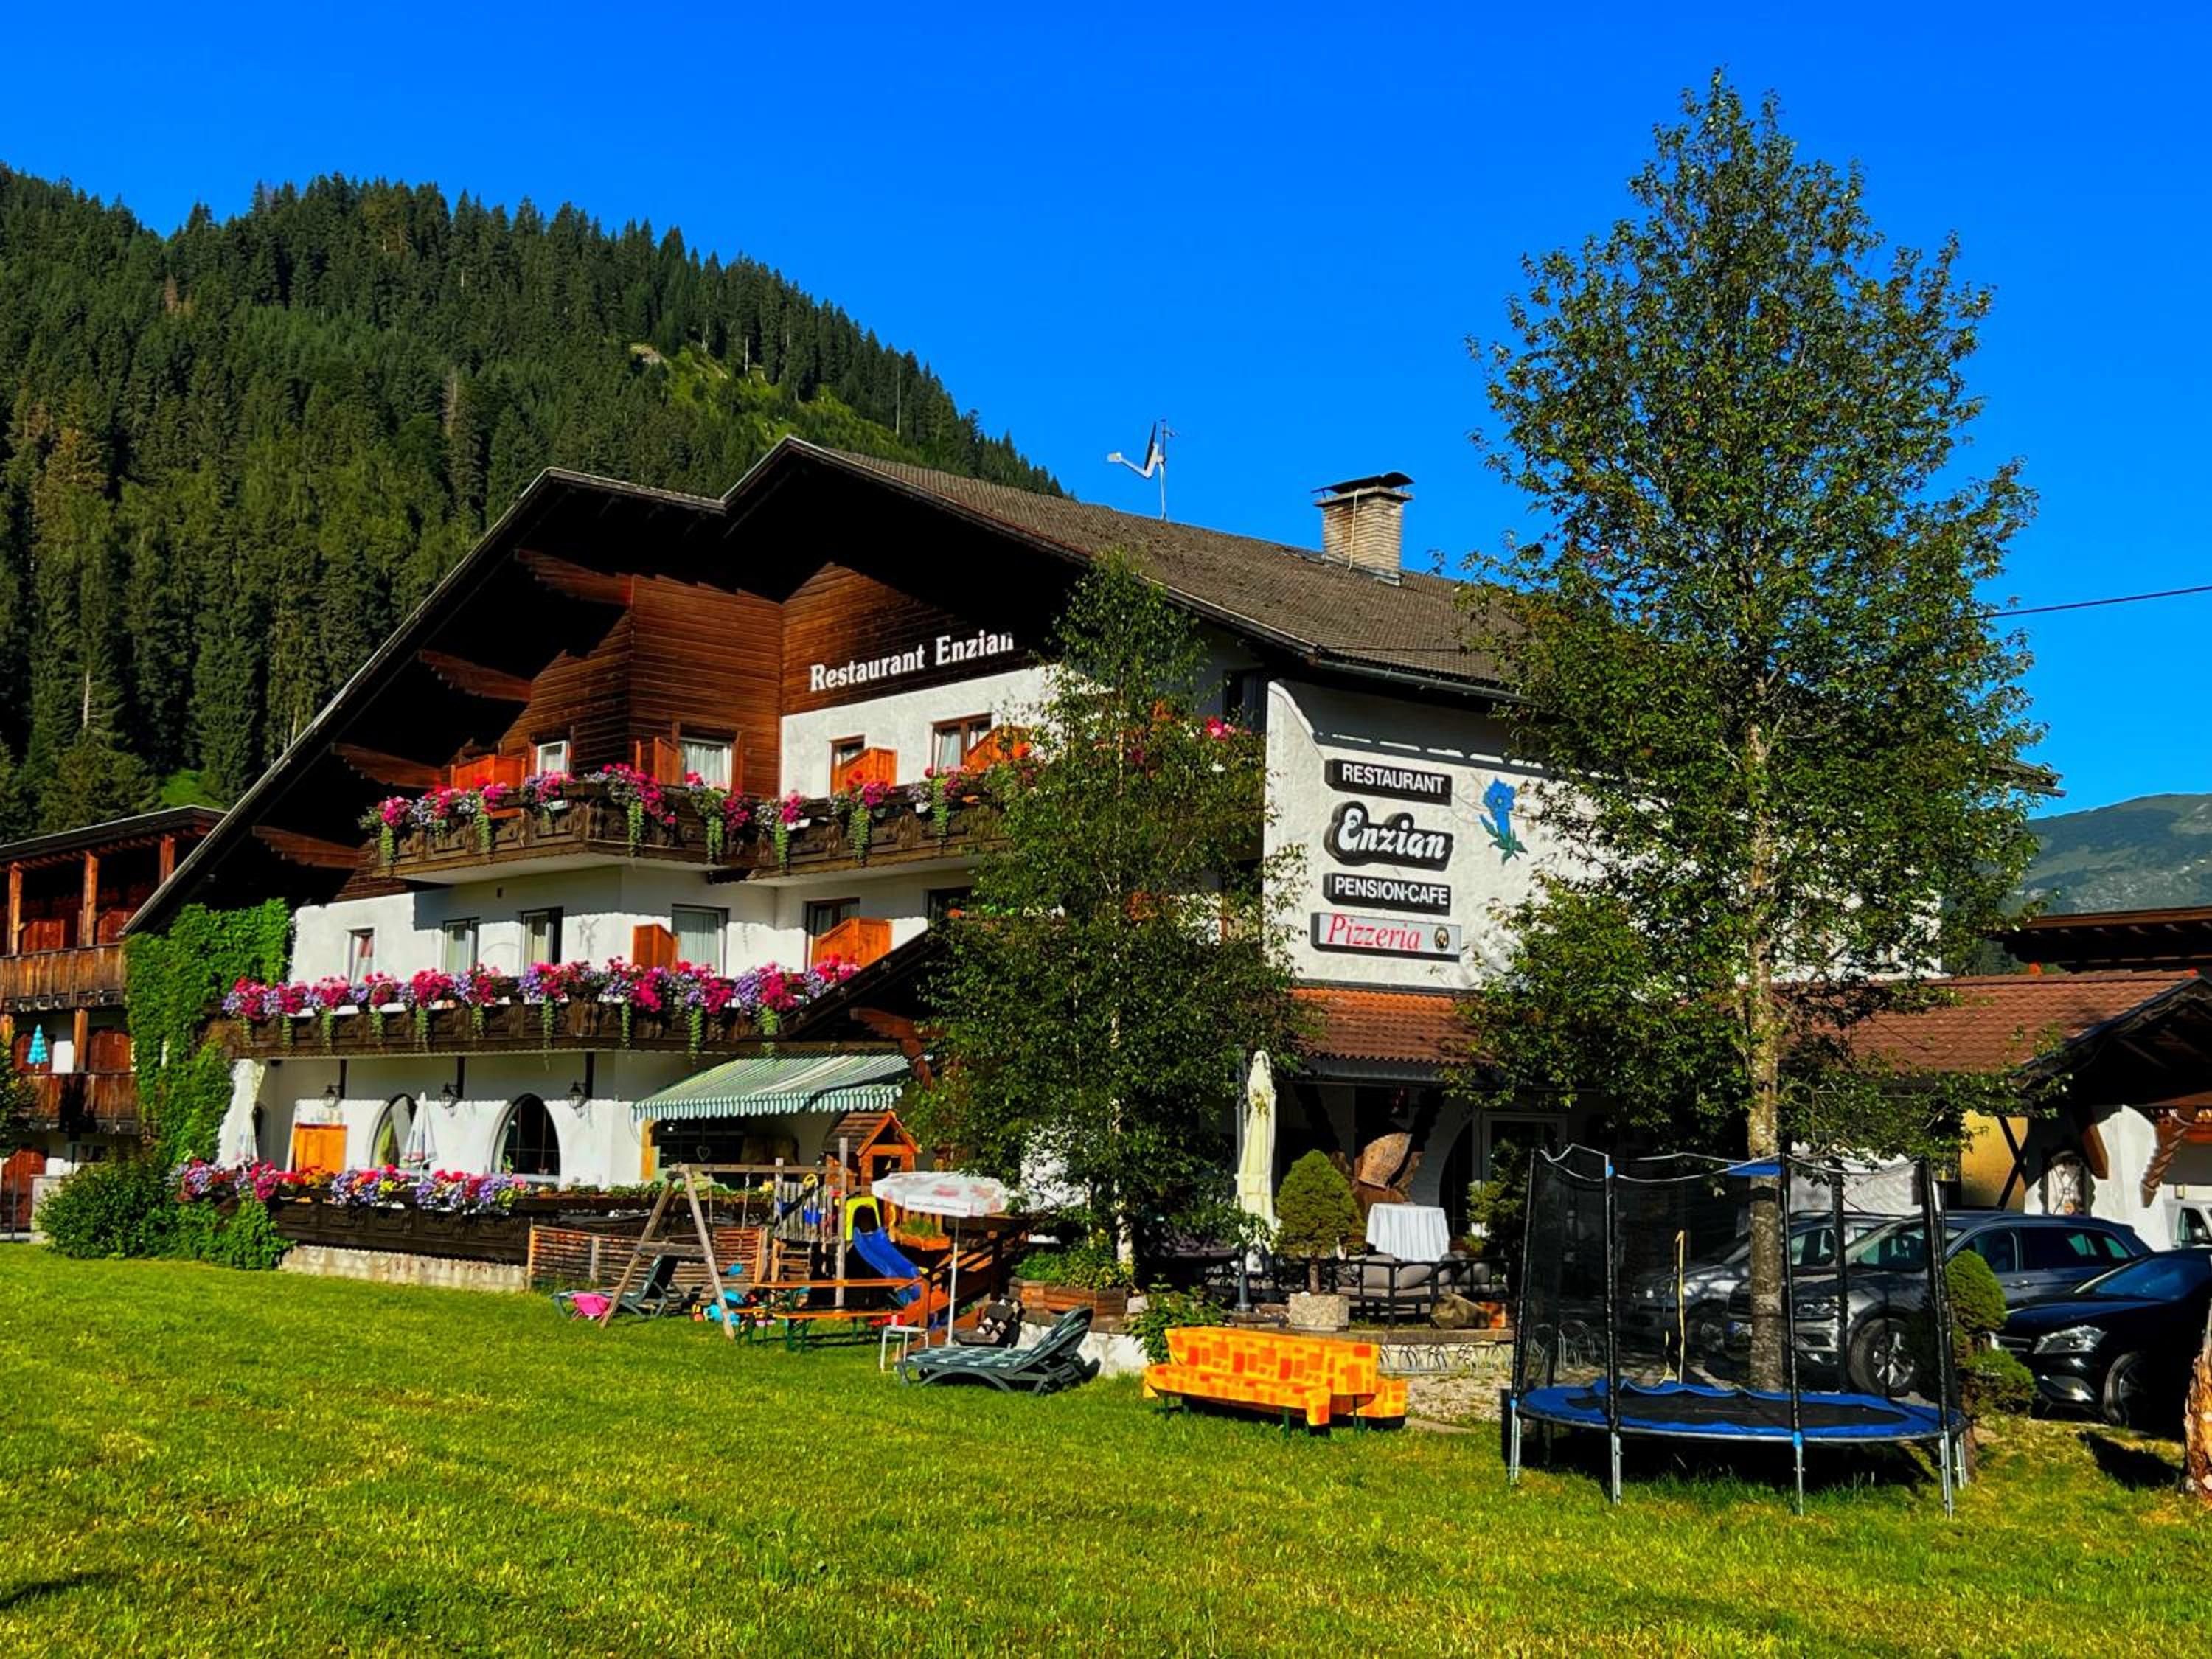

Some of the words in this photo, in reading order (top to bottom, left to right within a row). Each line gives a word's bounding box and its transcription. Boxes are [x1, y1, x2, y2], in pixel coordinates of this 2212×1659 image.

[810, 644, 925, 692] Restaurant
[935, 629, 1014, 665] Enzian
[1342, 762, 1445, 794] RESTAURANT
[1338, 807, 1446, 860] Enzian
[1326, 912, 1422, 951] Pizzeria
